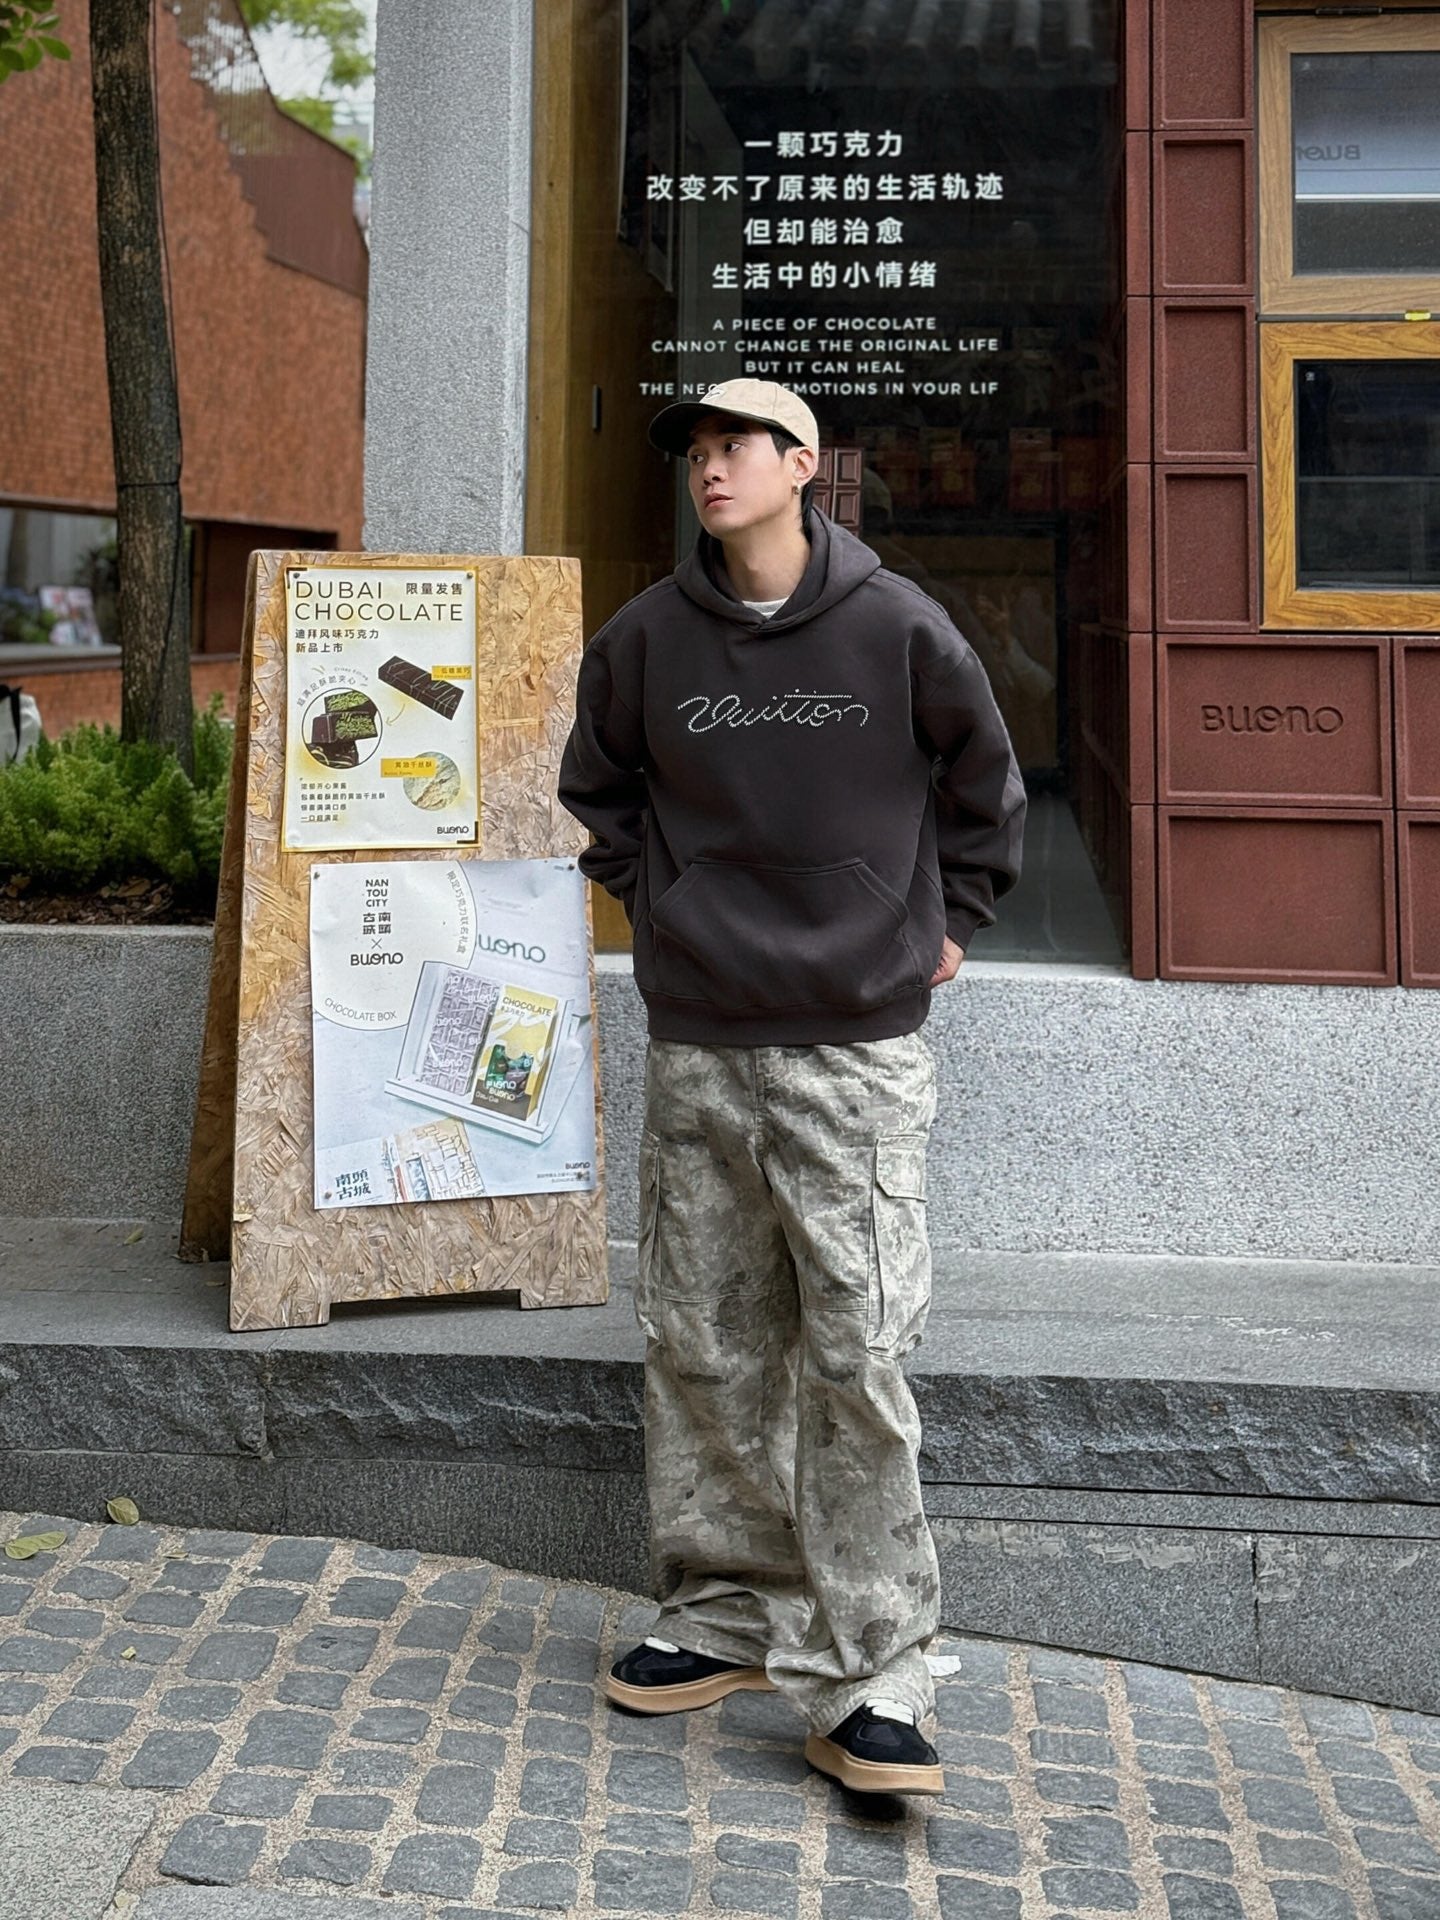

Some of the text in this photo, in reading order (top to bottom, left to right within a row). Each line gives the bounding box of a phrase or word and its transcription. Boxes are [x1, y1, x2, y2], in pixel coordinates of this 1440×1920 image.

[744, 130, 903, 158] 一颗巧克力
[646, 173, 1005, 201] 改变不了原来的生活轨迹
[744, 217, 904, 245] 但却能治愈
[712, 261, 938, 289] 生活中的小情绪
[713, 317, 936, 331] A PIECE OF CHOCOLATE
[651, 338, 998, 353] CANNOT CHANGE THE ORIGINAL LIFE
[745, 361, 904, 374] BUT IT CAN HEAL
[639, 383, 674, 395] THE
[885, 382, 904, 395] IN
[912, 382, 962, 395] YOUR
[970, 382, 998, 395] LIF
[296, 581, 382, 598] DUBAI
[406, 583, 463, 595] 限量发售
[294, 603, 463, 621] CHOCOLATE
[295, 628, 380, 640] 迪拜风味巧克力
[295, 642, 344, 654] 新品上市
[365, 879, 389, 888] NAN
[366, 889, 388, 898] TOU
[366, 899, 389, 908] CITY
[324, 997, 398, 1022] CHOCOLATE BOX
[502, 996, 552, 1017] CHOCOLATE
[336, 1182, 371, 1200] 古城
